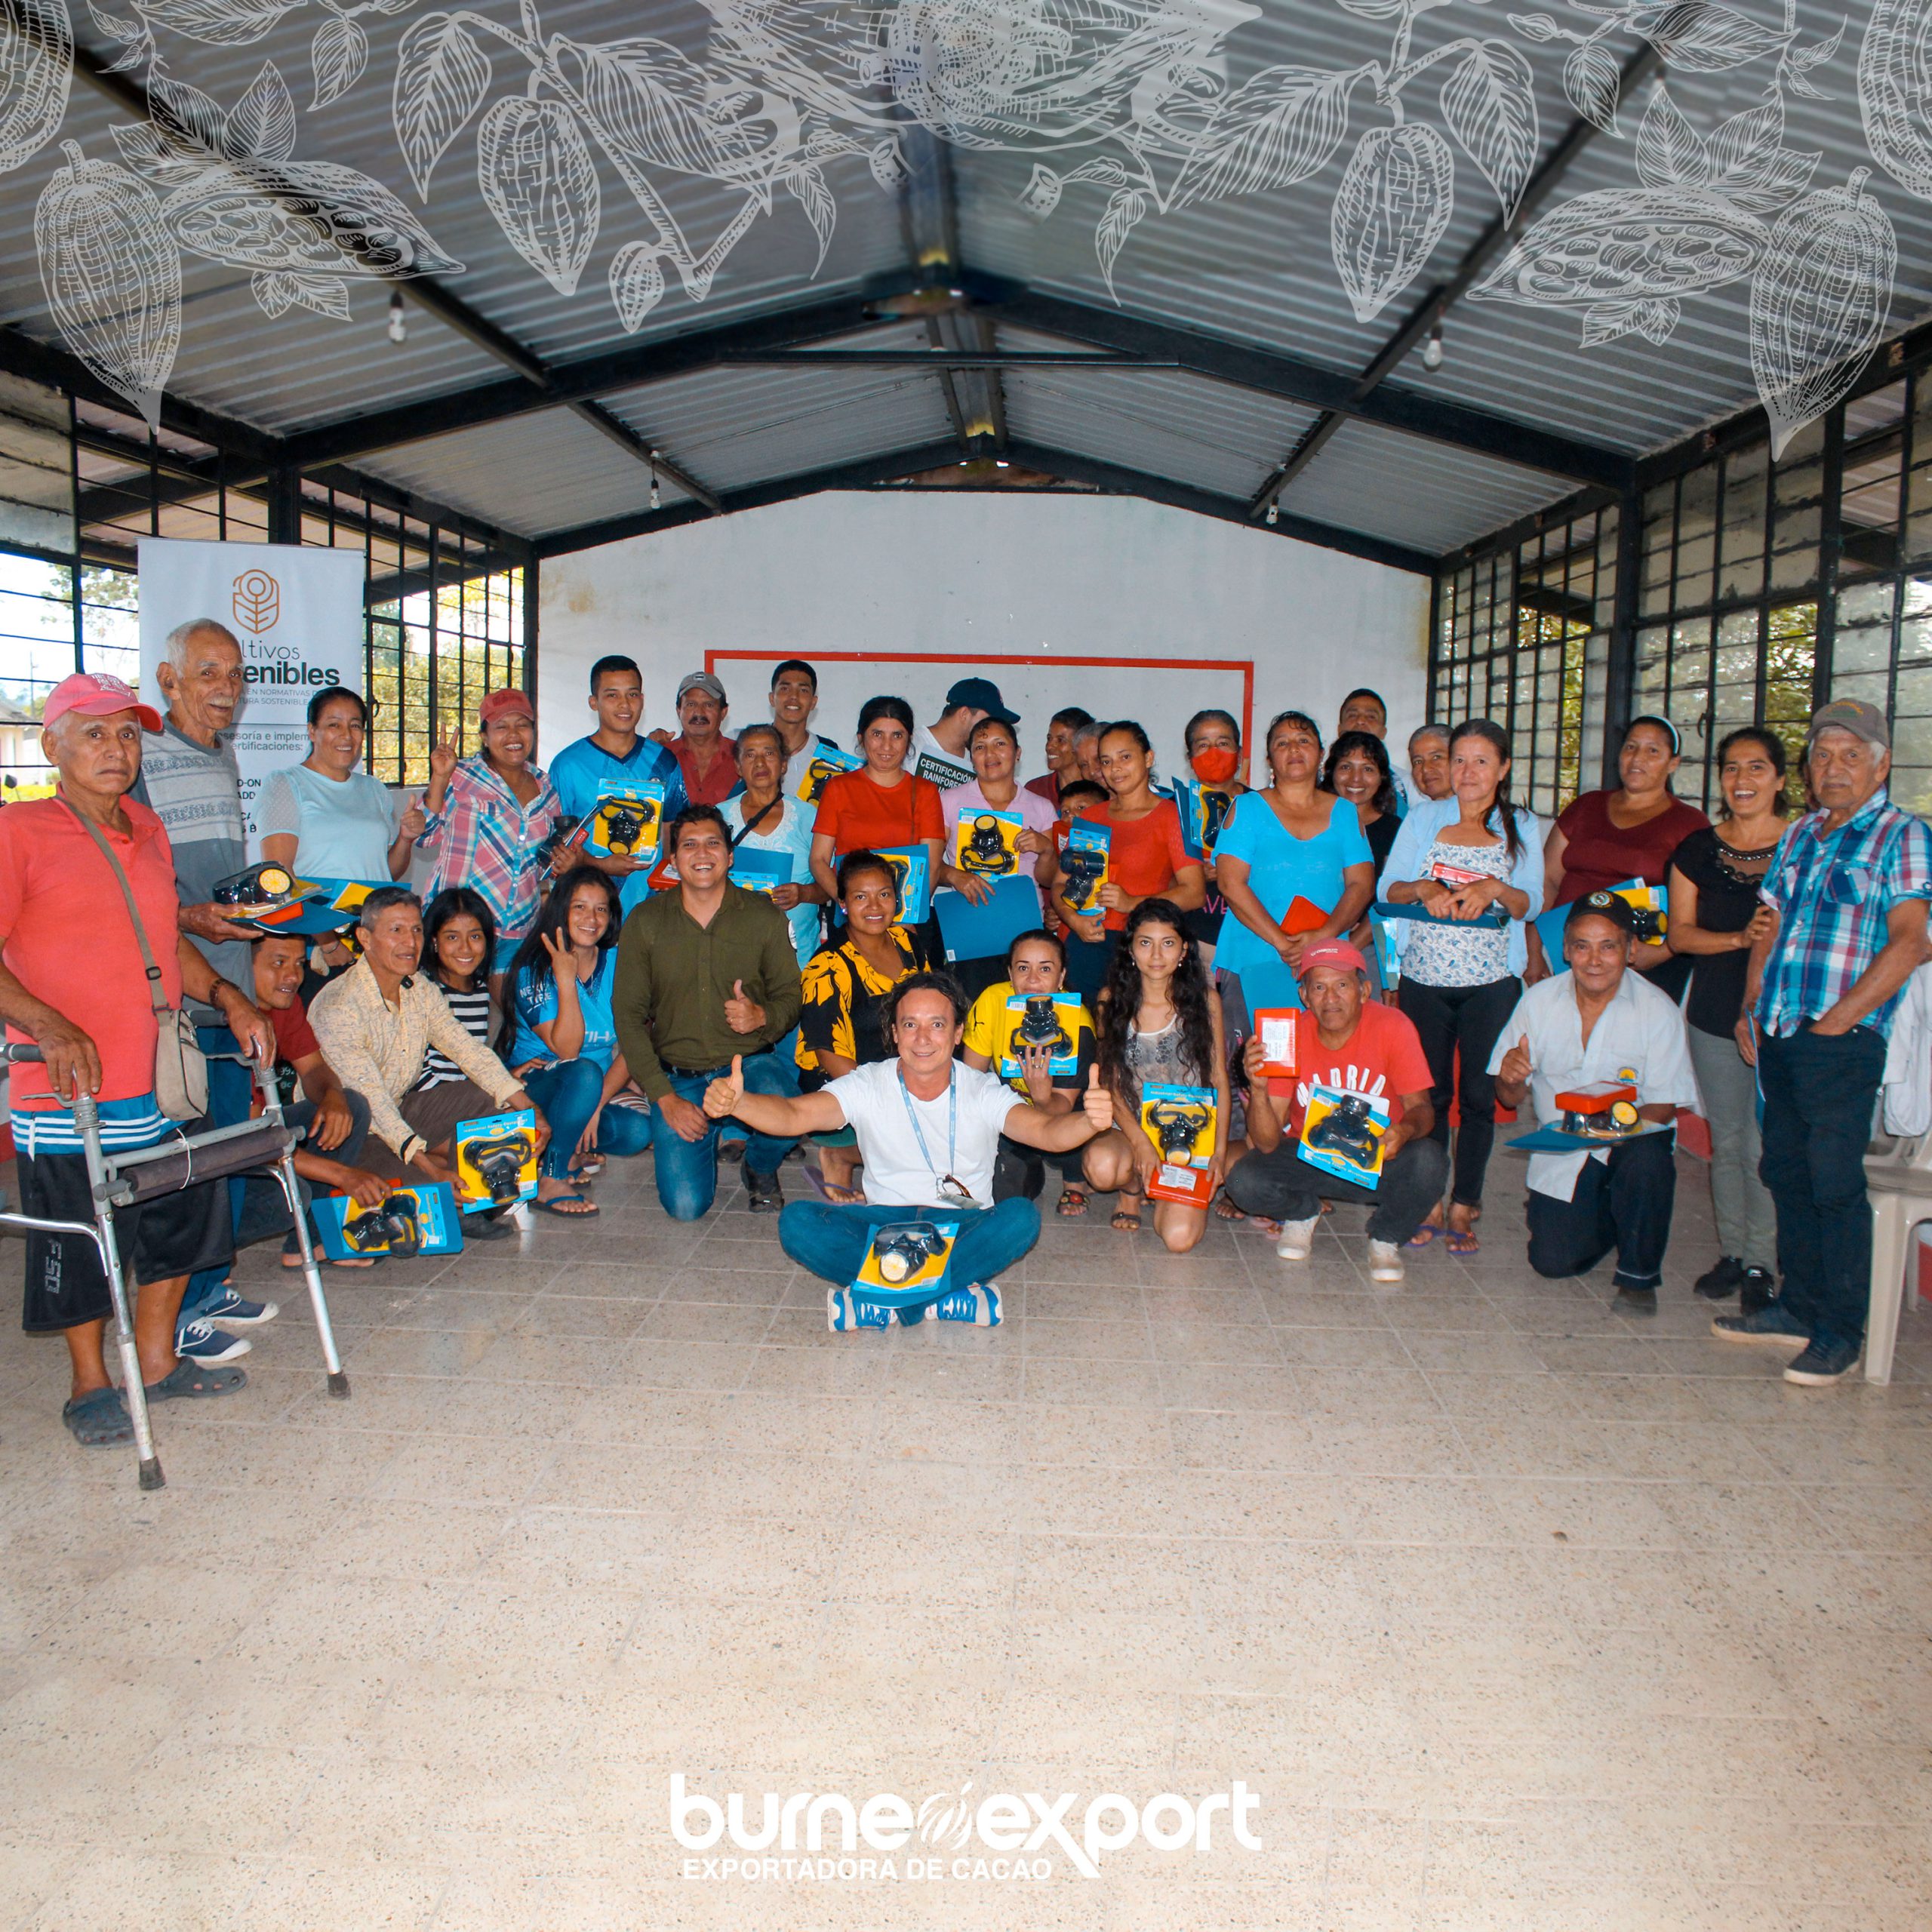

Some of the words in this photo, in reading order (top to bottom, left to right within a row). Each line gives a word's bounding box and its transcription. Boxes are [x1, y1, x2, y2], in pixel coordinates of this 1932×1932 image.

[242, 639, 300, 660] ltivos
[243, 660, 340, 686] enibles
[260, 688, 310, 697] NORMATIVAS
[274, 731, 309, 743] implem
[229, 741, 303, 752] ertificaciones:
[236, 778, 261, 787] D-ON
